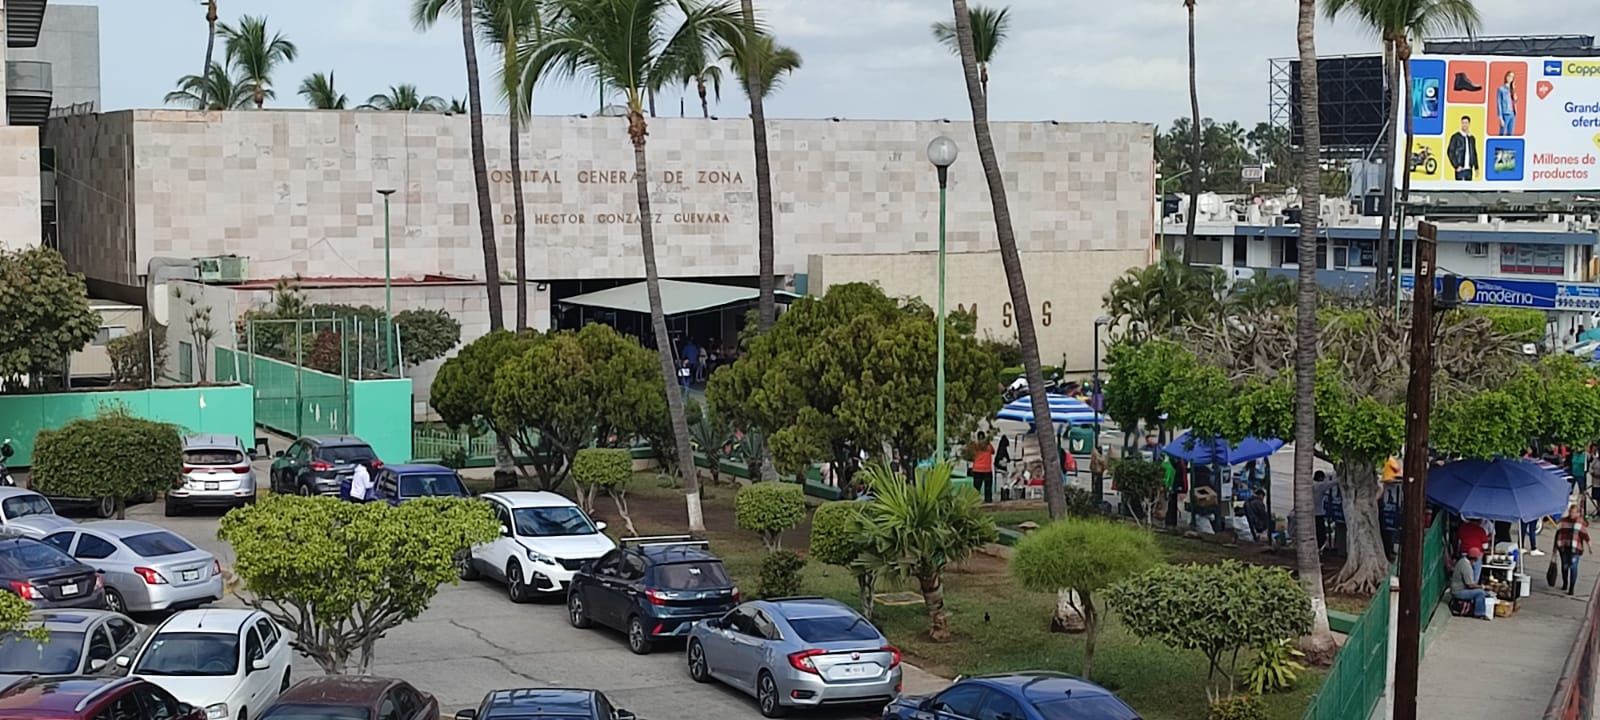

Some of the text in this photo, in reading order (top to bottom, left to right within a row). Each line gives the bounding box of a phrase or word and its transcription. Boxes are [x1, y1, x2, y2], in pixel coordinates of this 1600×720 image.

[1564, 101, 1600, 113] Grand
[1571, 116, 1600, 127] ofert
[1532, 153, 1596, 165] Millones de
[490, 170, 743, 184] OSITAL GENERA DE ZONA
[1532, 167, 1588, 181] productos
[534, 213, 586, 225] HECTOR
[598, 213, 662, 224] GONZAZ
[673, 212, 730, 224] GUEVARA
[1476, 290, 1533, 304] moderna
